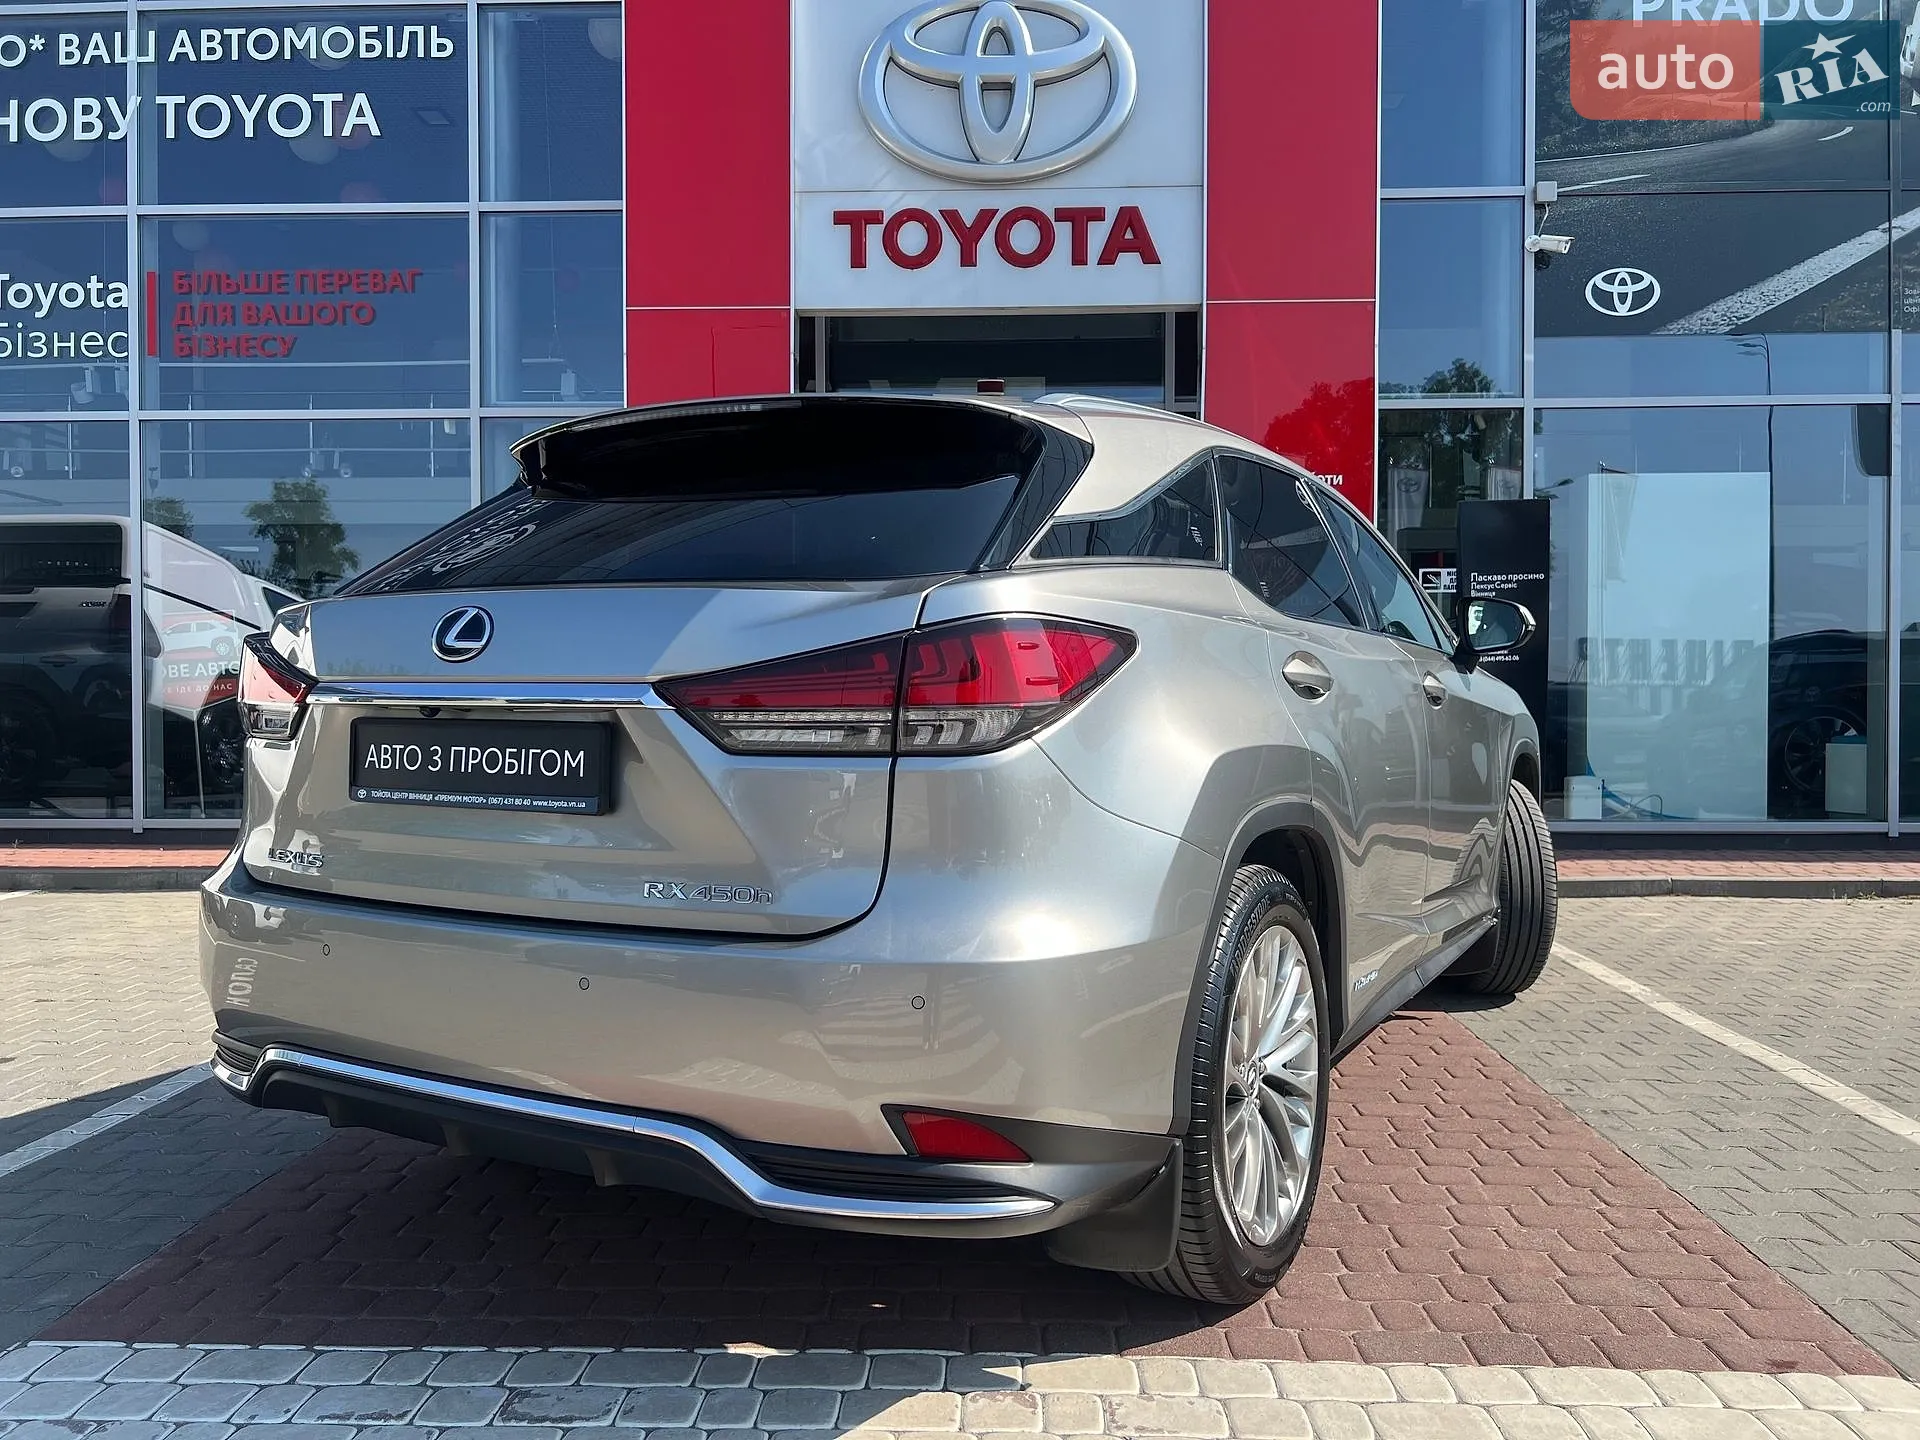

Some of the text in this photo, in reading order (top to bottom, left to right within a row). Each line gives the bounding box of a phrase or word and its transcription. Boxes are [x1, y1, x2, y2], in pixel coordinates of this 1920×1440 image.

[58, 30, 156, 66] ВАШ
[168, 25, 455, 62] АВТОМОБІЛЬ
[155, 92, 382, 140] TOYOTA
[833, 205, 1162, 270] TOYOTA
[172, 269, 423, 294] БІЛЬШЕ ПЕРЕВАГ
[172, 301, 376, 331] ДЛЯ ВАШОГО
[172, 333, 298, 358] БІЗНЕСУ
[1507, 572, 1545, 582] просимо
[364, 743, 422, 771] АВТО
[449, 746, 585, 778] ПРОБІГОМ
[370, 789, 391, 799] ТОЙОТА
[391, 791, 408, 800] ЦЕНТР
[408, 792, 433, 801] ВІННИЦЯ
[488, 796, 503, 806] (067)
[503, 797, 514, 805] 431
[514, 798, 523, 806] 80
[523, 798, 531, 806] 40
[532, 798, 586, 809] www.toyota.vn.ua
[267, 847, 325, 868] LEXUS
